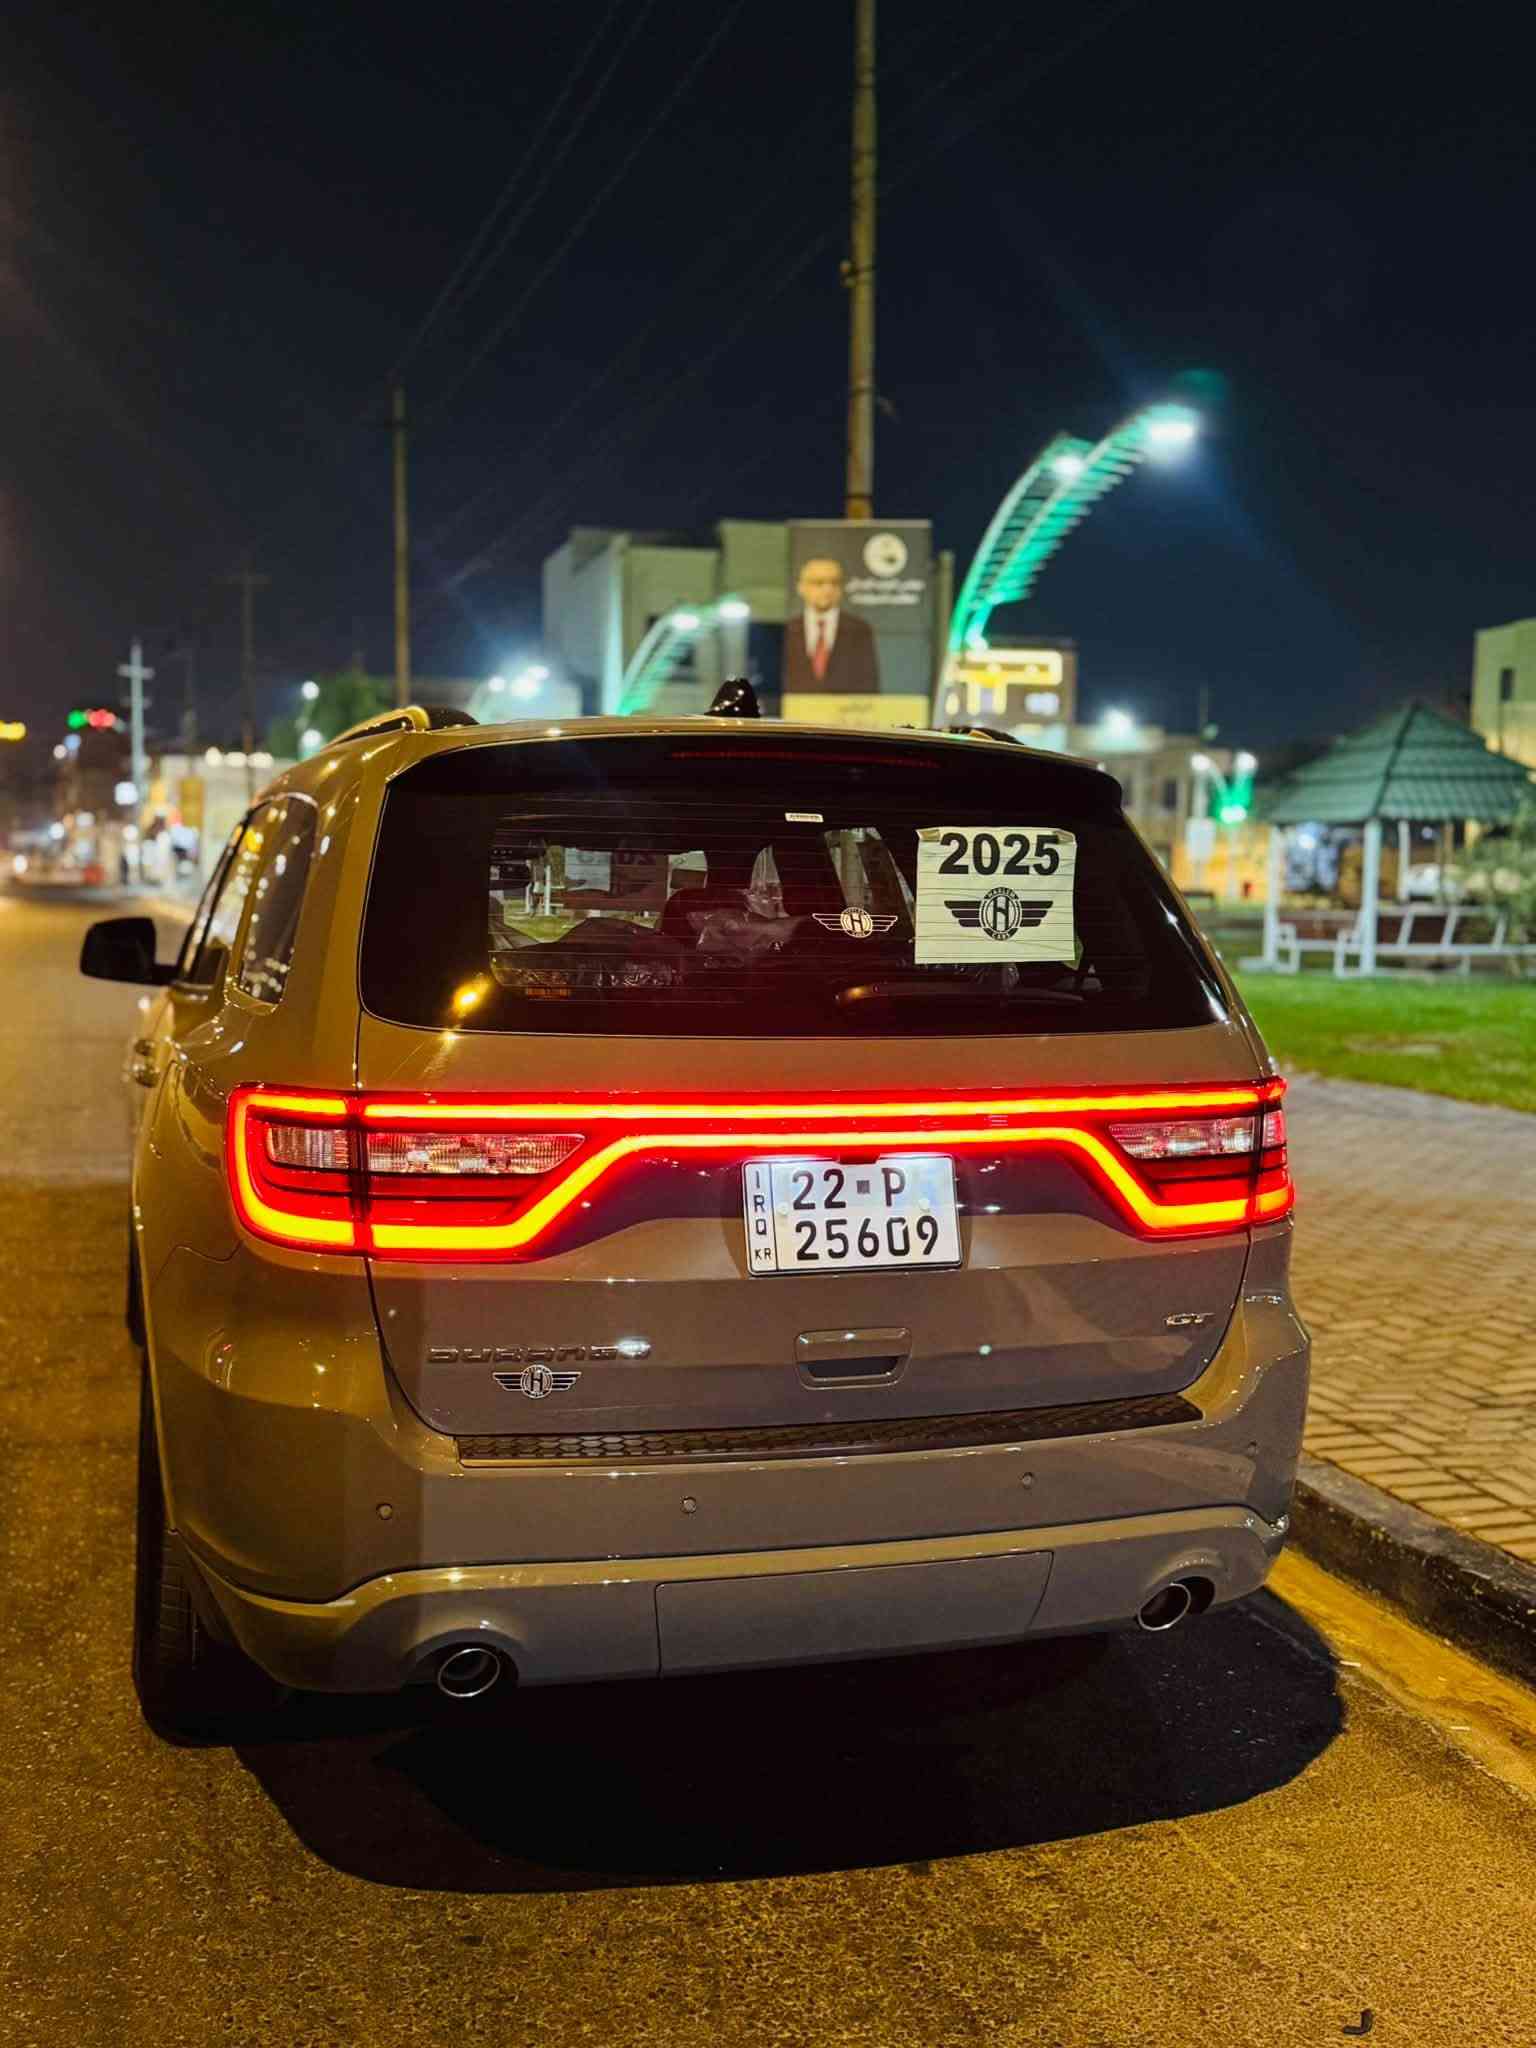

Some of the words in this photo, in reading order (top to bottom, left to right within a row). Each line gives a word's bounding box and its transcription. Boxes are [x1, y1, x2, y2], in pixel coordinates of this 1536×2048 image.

[939, 833, 1059, 875] 2025
[792, 1168, 847, 1210] 22
[881, 1167, 906, 1207] P
[755, 1247, 772, 1261] KR
[795, 1215, 938, 1260] 25609
